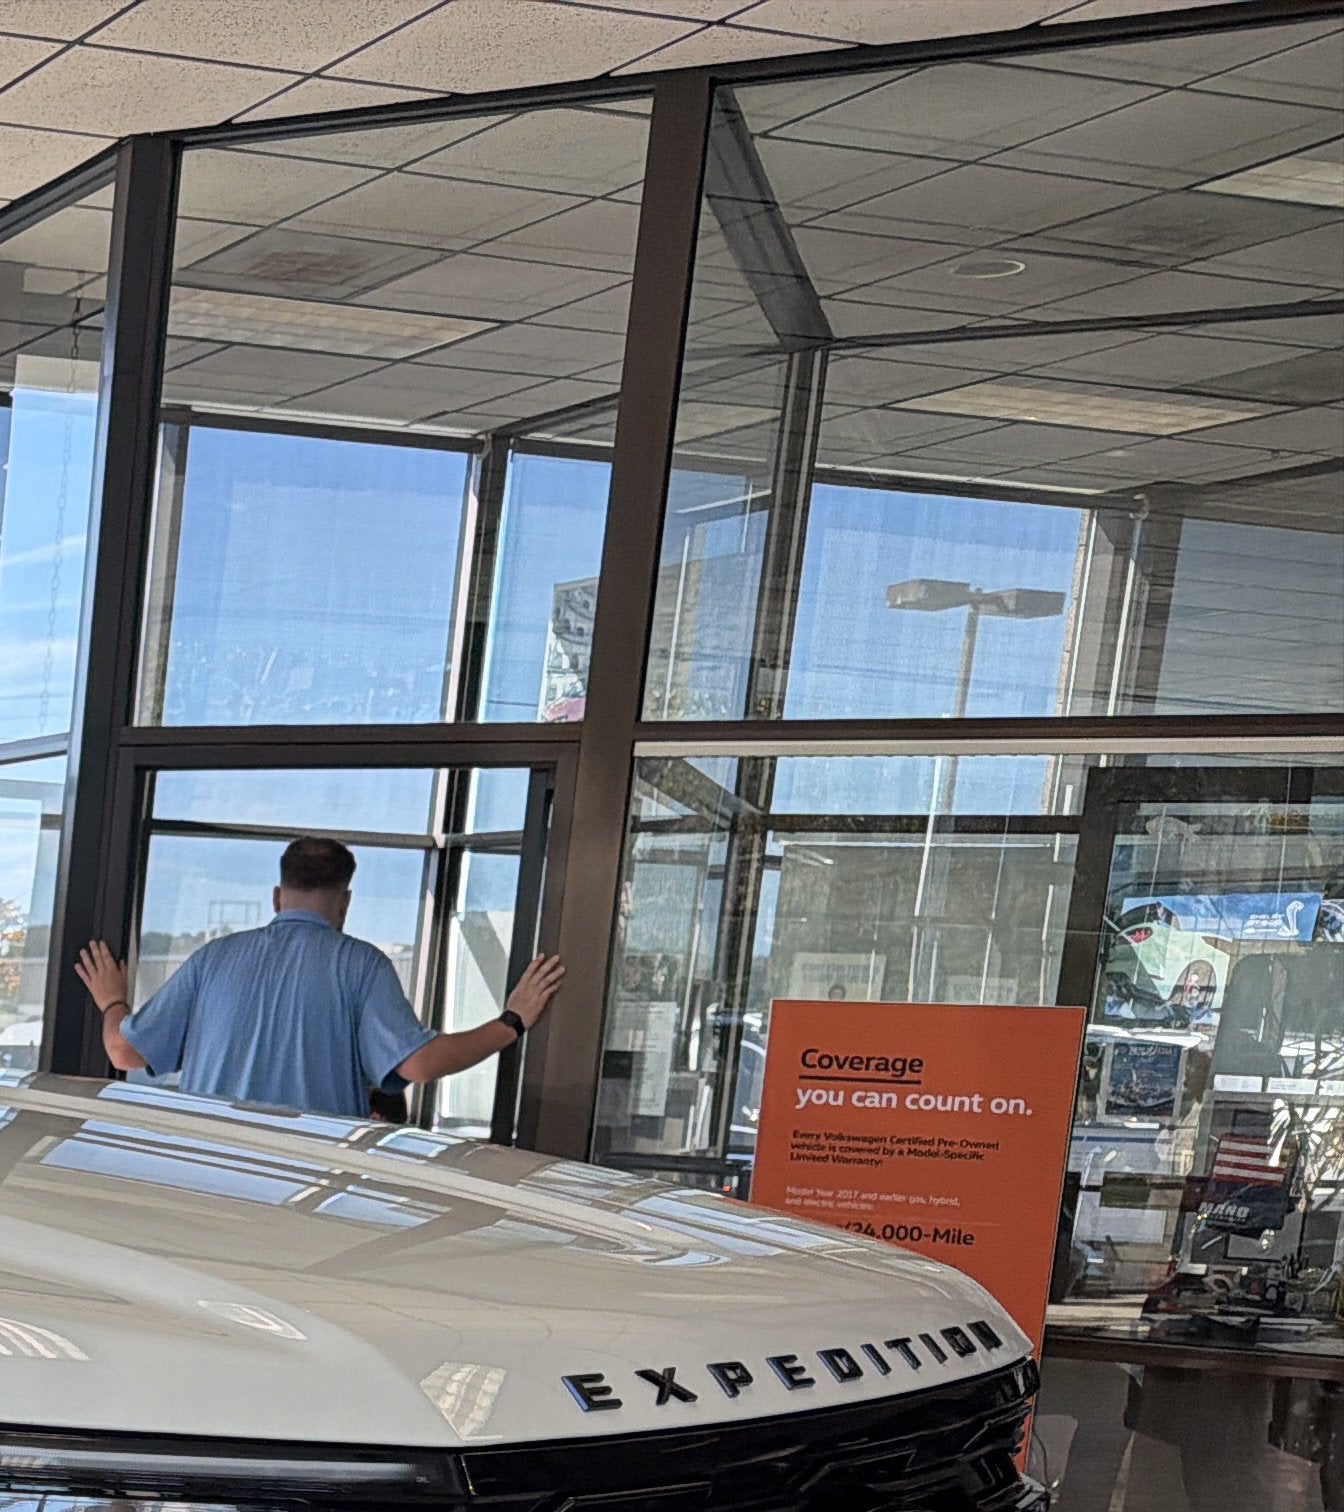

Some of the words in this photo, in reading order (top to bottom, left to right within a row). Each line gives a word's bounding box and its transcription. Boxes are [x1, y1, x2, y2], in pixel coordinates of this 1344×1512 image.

[800, 1048, 924, 1077] Coverage
[795, 1086, 844, 1109] you
[851, 1090, 897, 1109] can
[904, 1092, 982, 1114] count
[990, 1098, 1033, 1116] on.
[793, 1129, 821, 1140] Every
[824, 1132, 887, 1145] Volkswagen
[890, 1135, 934, 1146] Certified
[790, 1152, 829, 1163] Limited
[838, 1145, 881, 1155] covered
[882, 1147, 895, 1157] by
[837, 1190, 859, 1198] 2017
[561, 1320, 1003, 1413] EXPEDITION
